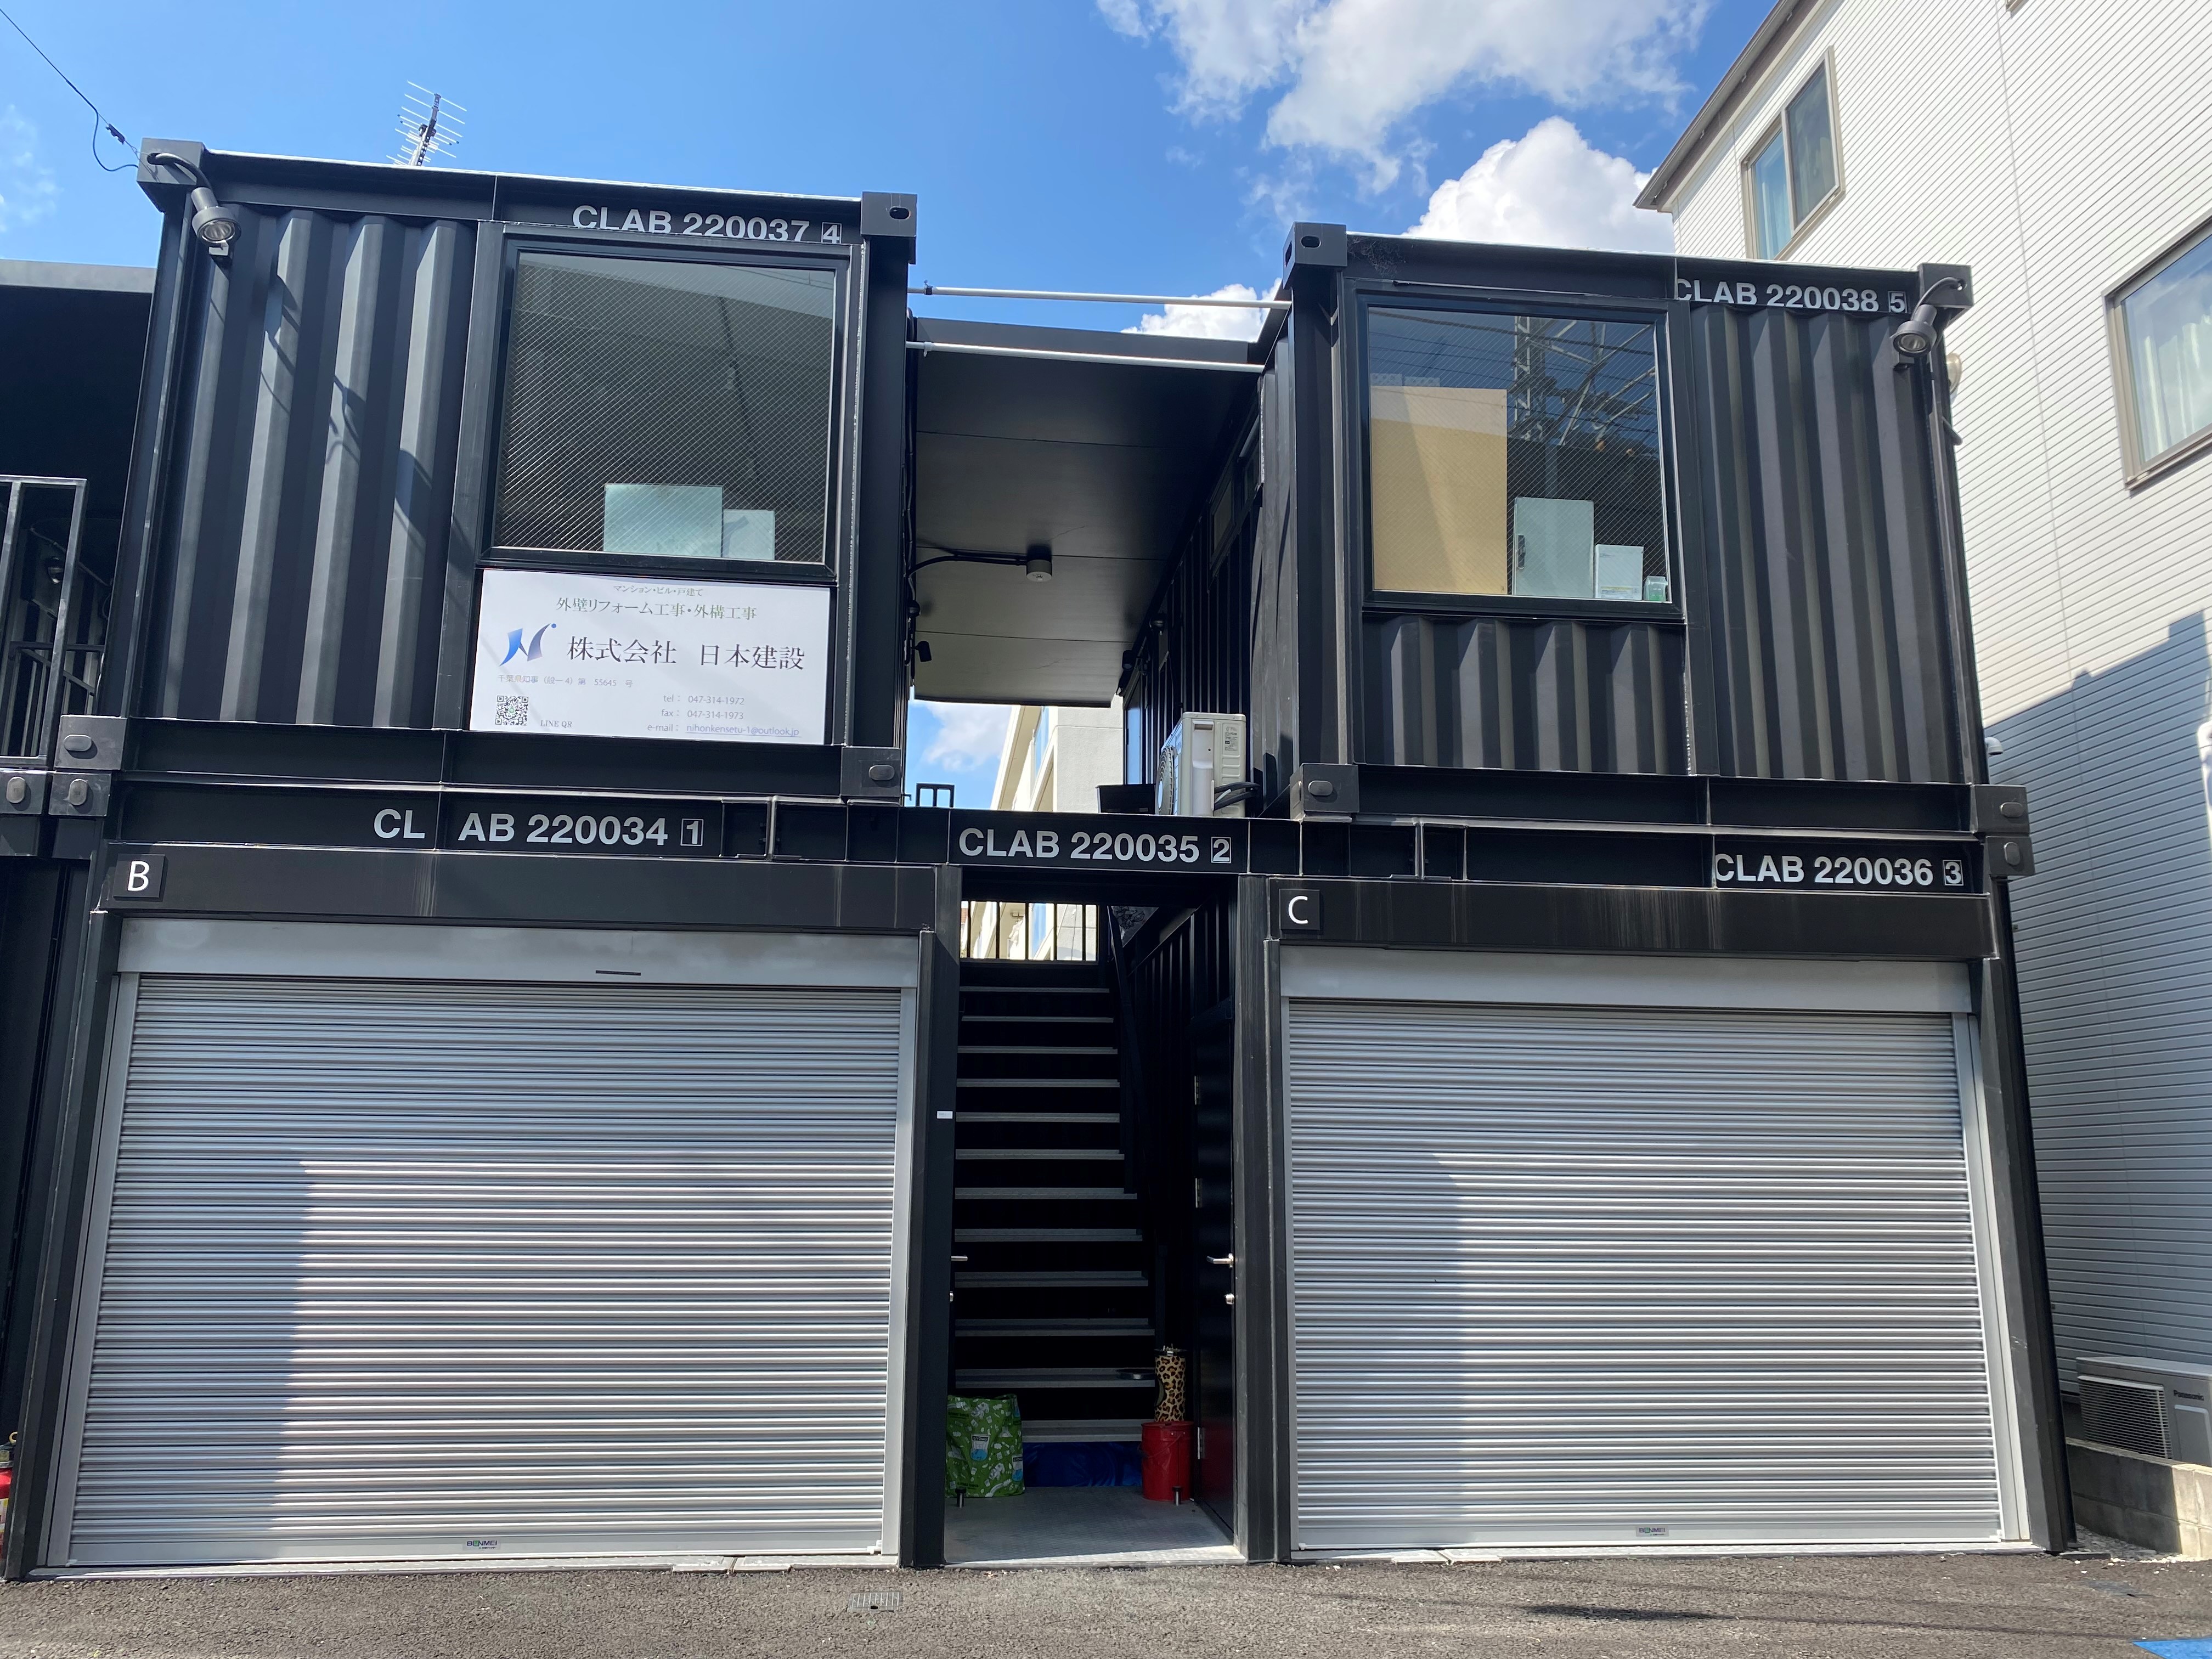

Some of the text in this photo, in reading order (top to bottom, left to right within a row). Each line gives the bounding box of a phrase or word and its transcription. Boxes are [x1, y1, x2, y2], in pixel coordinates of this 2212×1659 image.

[572, 205, 840, 244] CLAB 220037 4
[1675, 278, 1906, 312] CLAB 220038 5
[556, 597, 757, 620] 外壁リフォーム工事・外構工事
[567, 635, 805, 670] 株式会社 日本建設
[687, 710, 744, 720] 047-314-1973
[688, 695, 744, 705] 047-314-1972
[686, 725, 799, 737] nihonkensetu-1@outlook.jp
[526, 814, 668, 846] 220034
[684, 820, 701, 845] 1
[959, 828, 1231, 863] CLAB 220035 2
[127, 860, 150, 891] B
[1715, 854, 1963, 886] CLAB 220036 3
[1288, 895, 1308, 924] C
